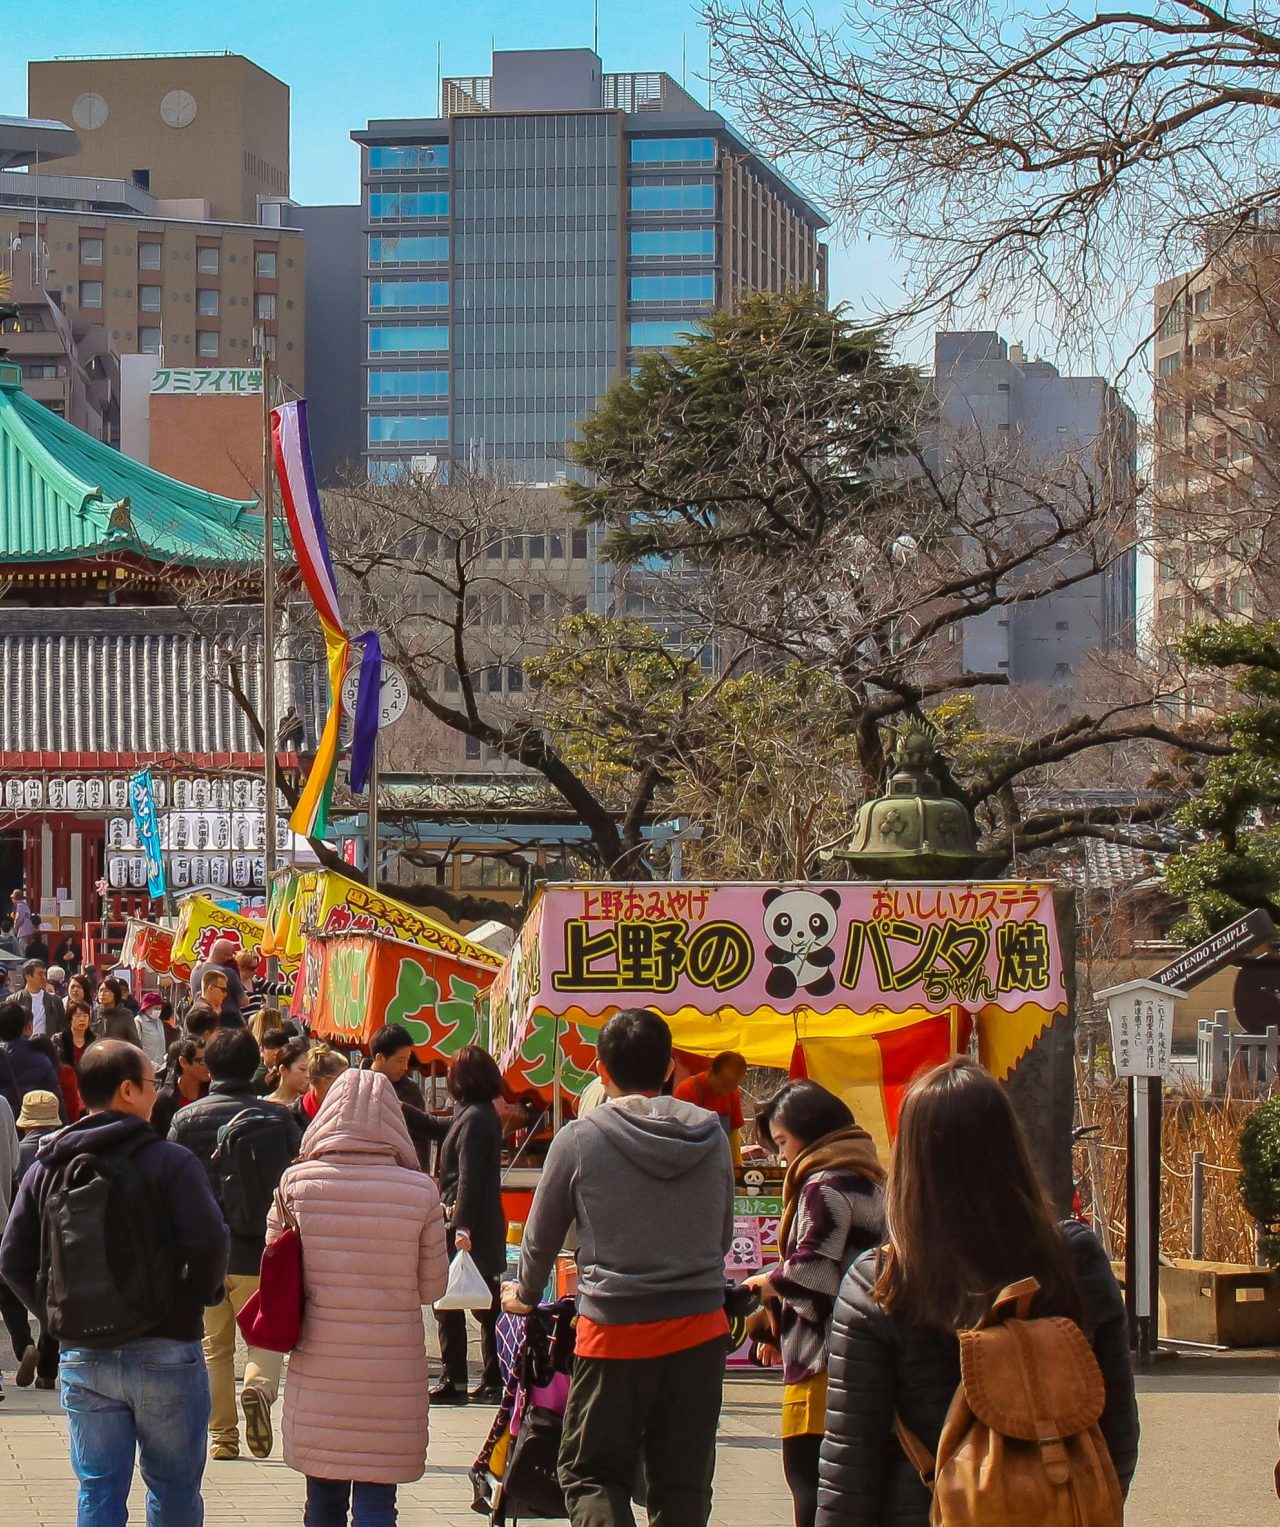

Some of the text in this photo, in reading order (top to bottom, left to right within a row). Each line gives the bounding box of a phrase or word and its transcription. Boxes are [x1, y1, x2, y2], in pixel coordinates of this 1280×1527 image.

[152, 370, 263, 392] クミアイ化学
[347, 690, 354, 699] 9
[394, 689, 401, 698] 3
[382, 709, 389, 718] 5
[391, 701, 397, 709] 4
[579, 890, 710, 921] 上野おみやげ
[872, 890, 1042, 920] おいしいカステラ
[551, 918, 755, 993] 上野の
[1160, 922, 1249, 984] BENTENDO TEMPLE
[734, 1199, 784, 1214] 乳たっ
